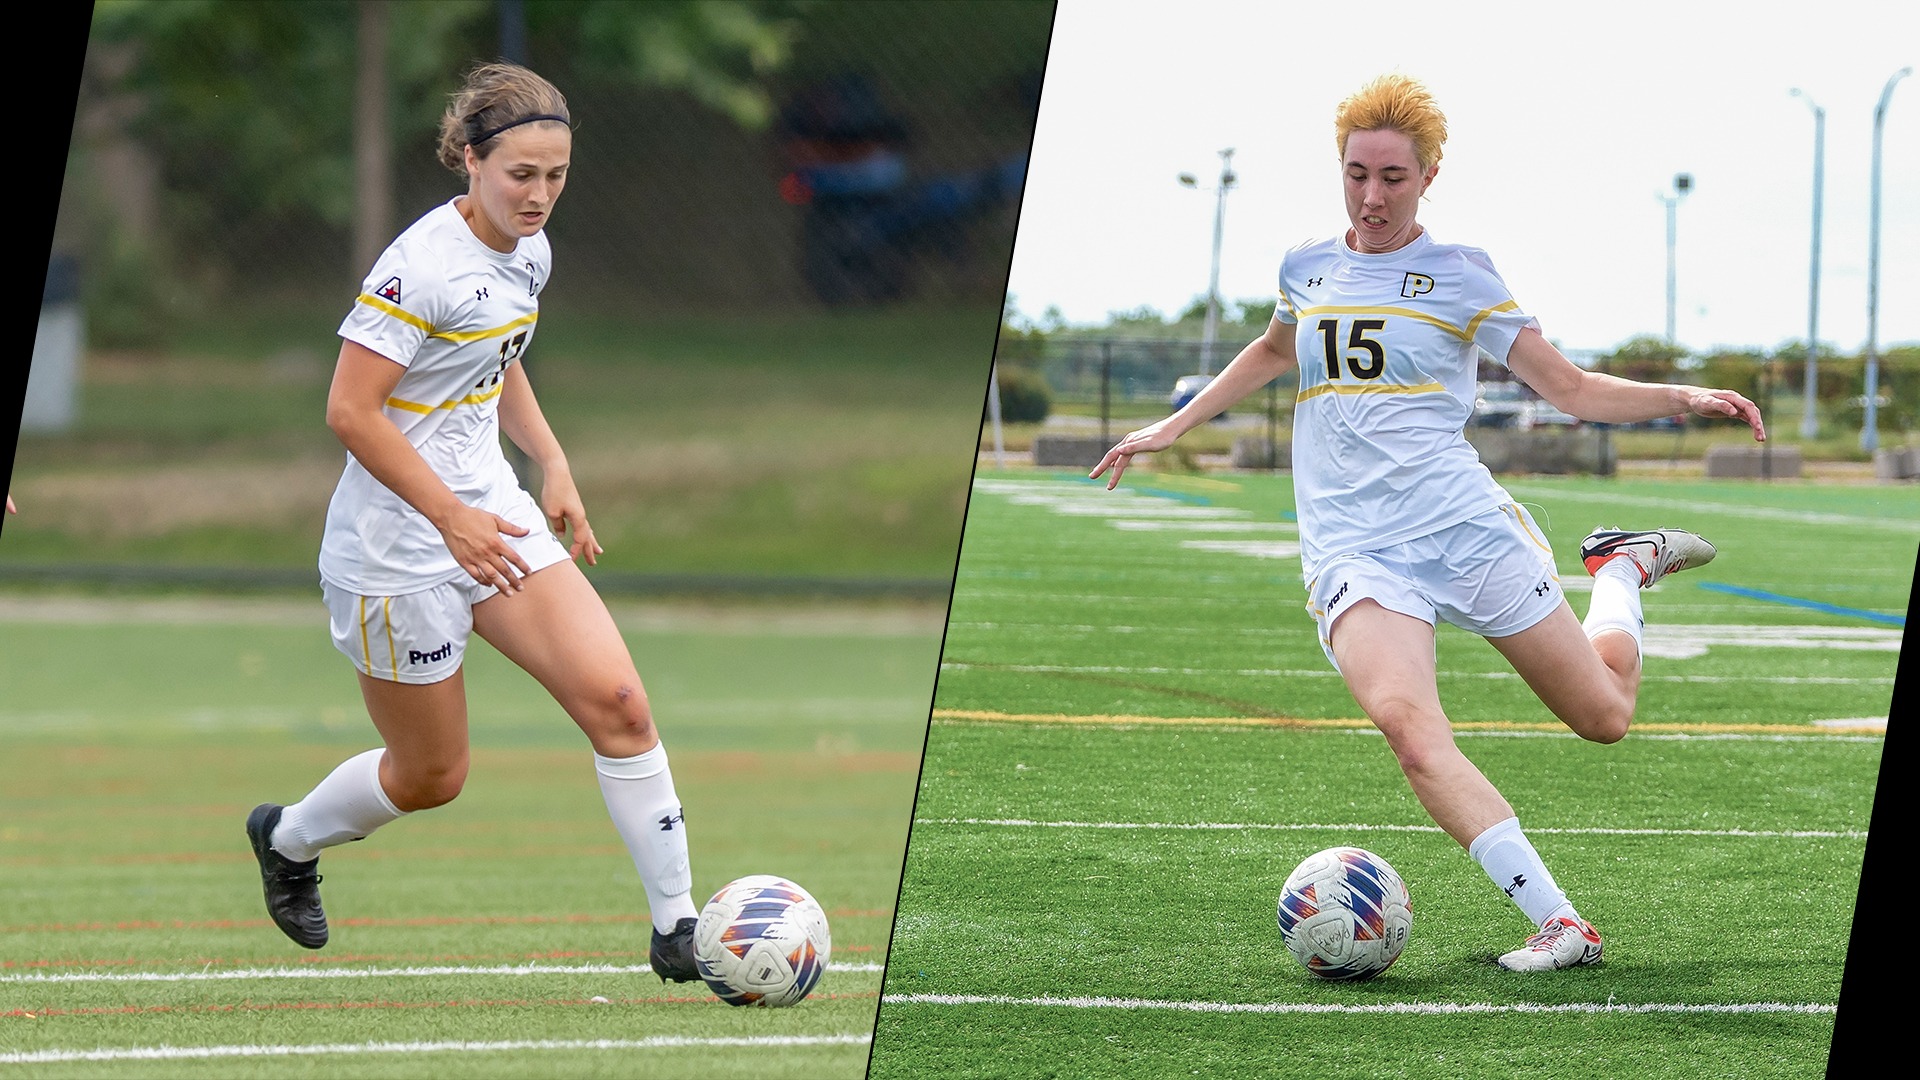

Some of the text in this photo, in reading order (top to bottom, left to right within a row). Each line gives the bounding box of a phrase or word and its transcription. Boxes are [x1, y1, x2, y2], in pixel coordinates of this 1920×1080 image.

[1400, 271, 1435, 298] P
[1317, 319, 1387, 381] 15
[408, 641, 452, 666] Pratt
